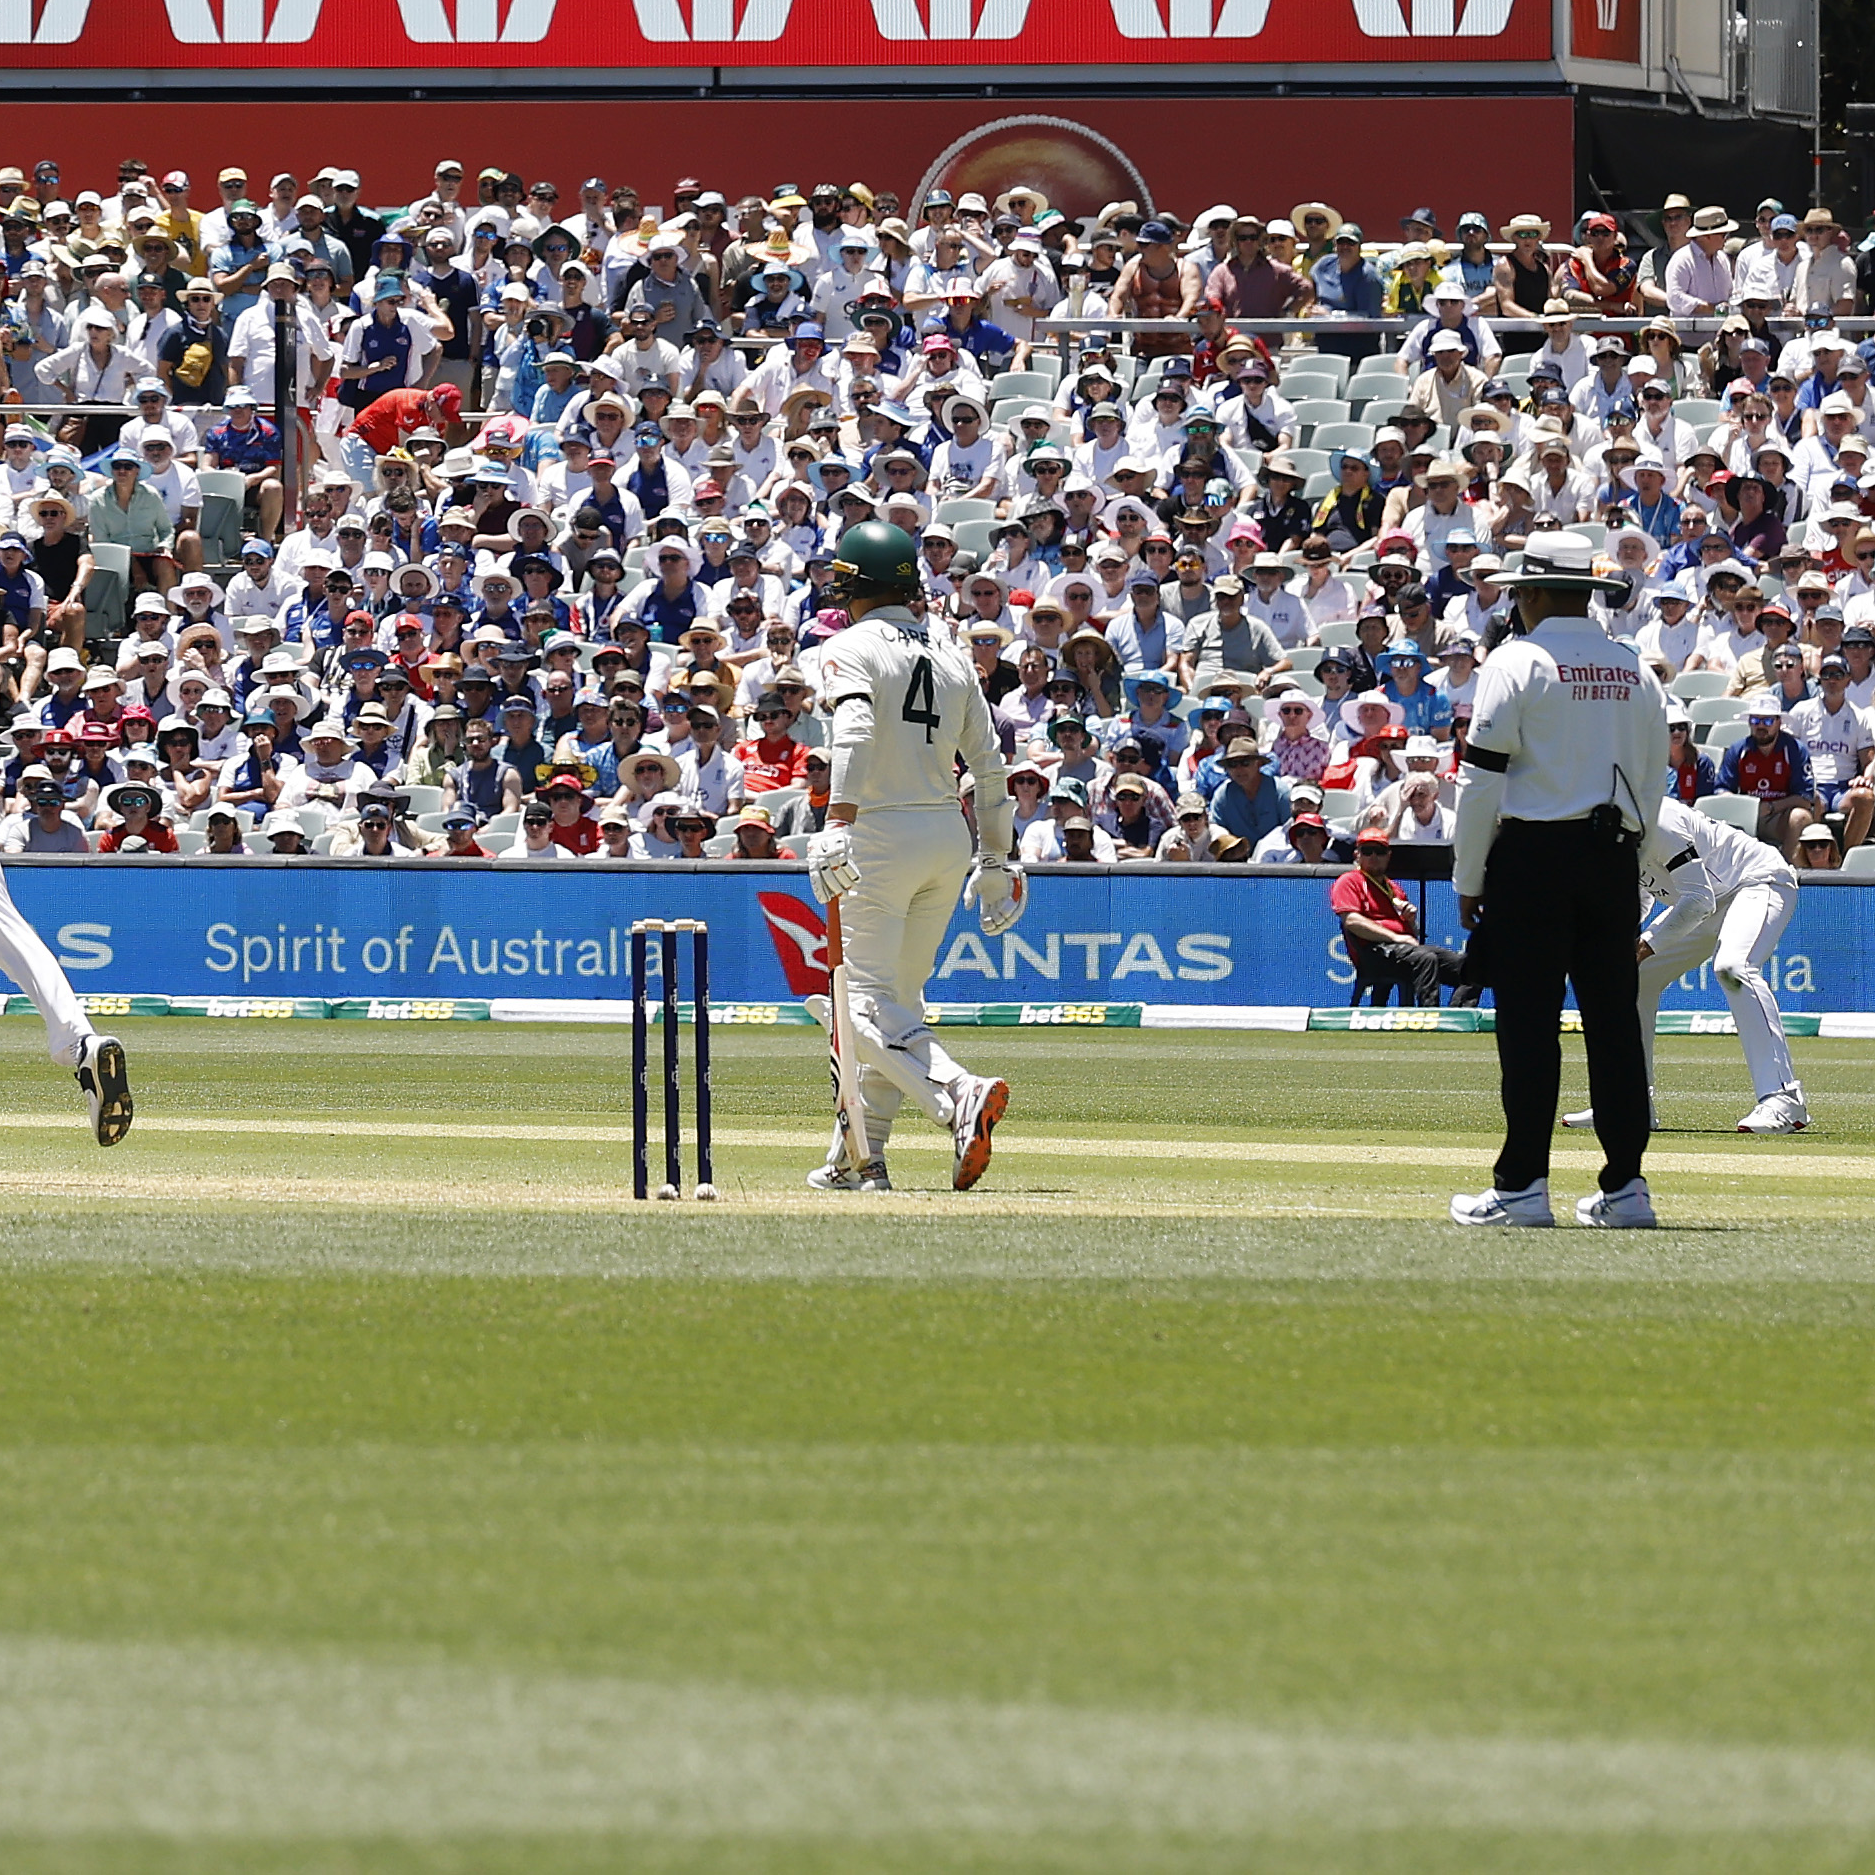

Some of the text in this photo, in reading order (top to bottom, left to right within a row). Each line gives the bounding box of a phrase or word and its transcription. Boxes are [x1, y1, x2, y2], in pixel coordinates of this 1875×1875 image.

[1556, 662, 1641, 686] Emirates
[902, 654, 941, 745] 4
[1571, 683, 1631, 702] FLY BETTER
[1806, 737, 1850, 754] cinch
[204, 922, 348, 983] Spirit
[361, 922, 416, 974] of
[207, 998, 295, 1018] bet365
[367, 998, 455, 1019] bet365
[1019, 1004, 1107, 1025] bet365
[1350, 1009, 1440, 1032] bet365
